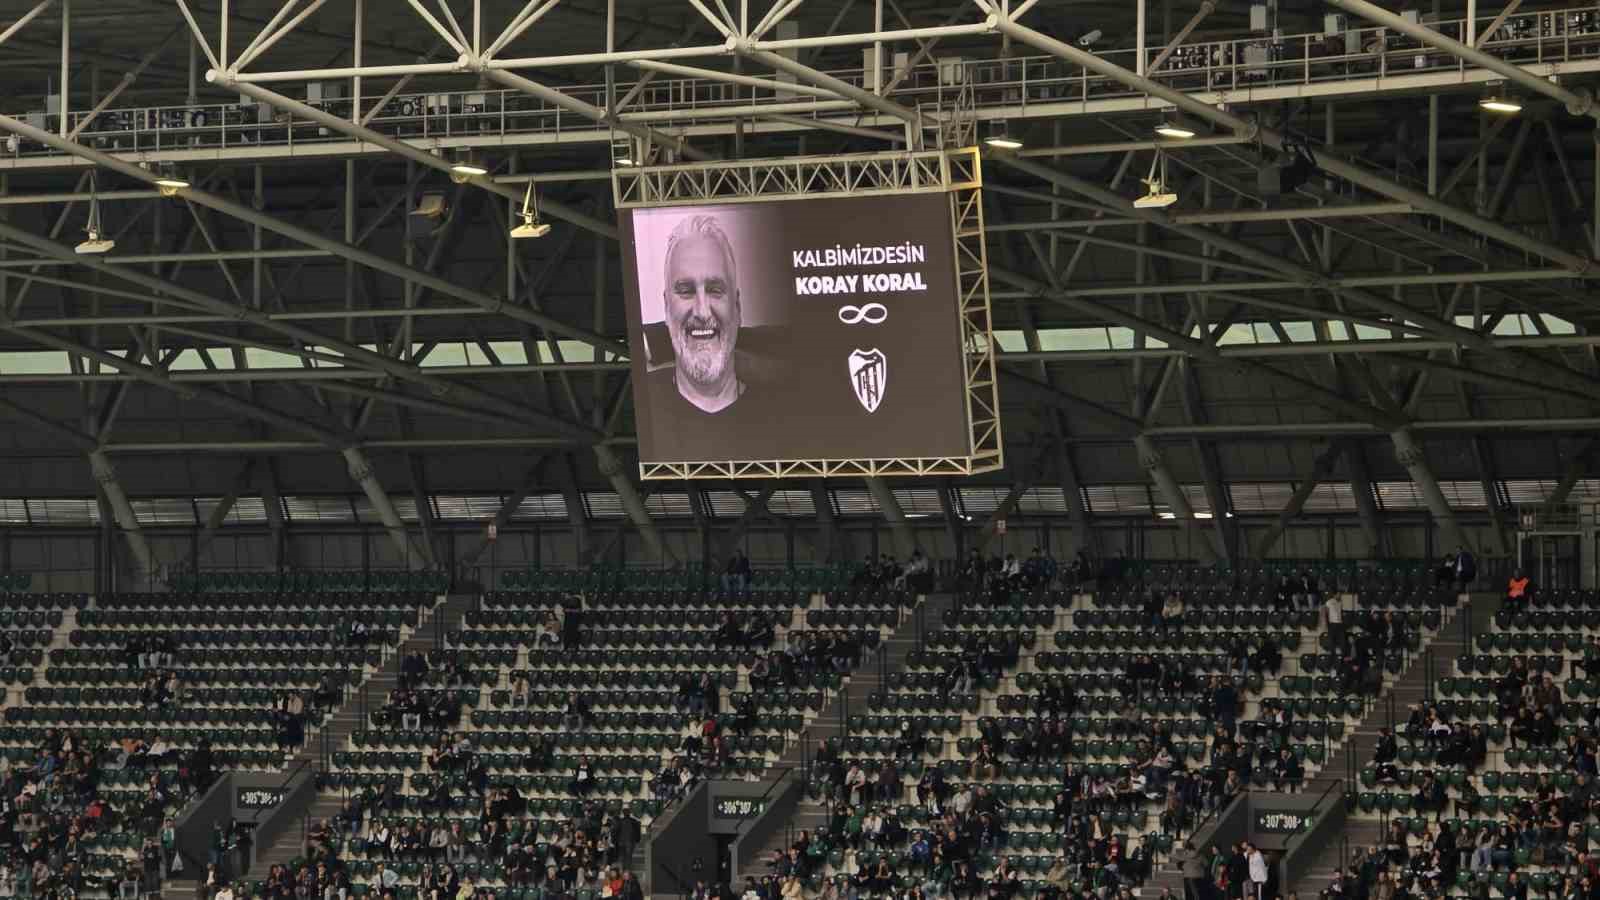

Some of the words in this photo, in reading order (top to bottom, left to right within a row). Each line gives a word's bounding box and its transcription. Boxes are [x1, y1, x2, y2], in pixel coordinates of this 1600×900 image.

[793, 241, 924, 267] KALBİMİZDESİN
[795, 275, 859, 295] KORAY
[863, 272, 927, 292] KORAL
